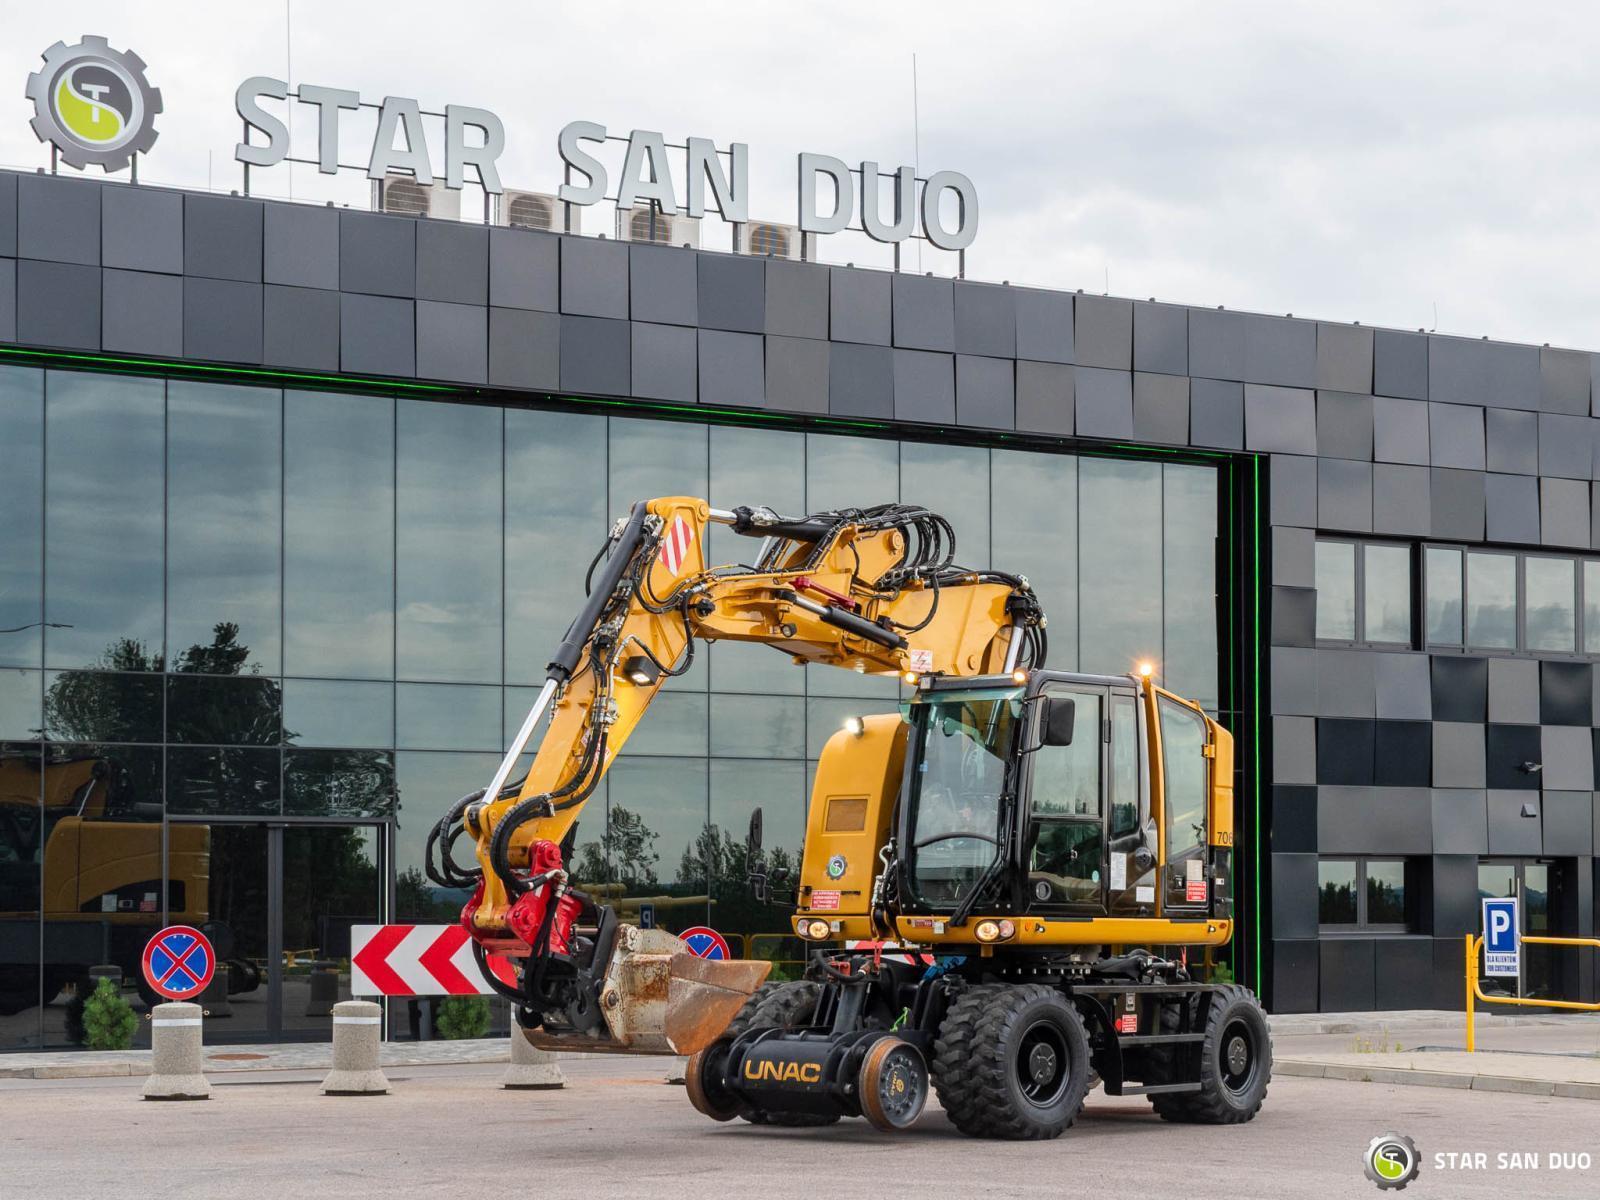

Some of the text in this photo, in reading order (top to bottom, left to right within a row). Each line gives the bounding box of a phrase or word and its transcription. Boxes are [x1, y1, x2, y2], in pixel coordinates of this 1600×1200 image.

[234, 76, 979, 251] STAR SAN DUO
[1490, 909, 1510, 946] P
[745, 1059, 821, 1083] UNAC
